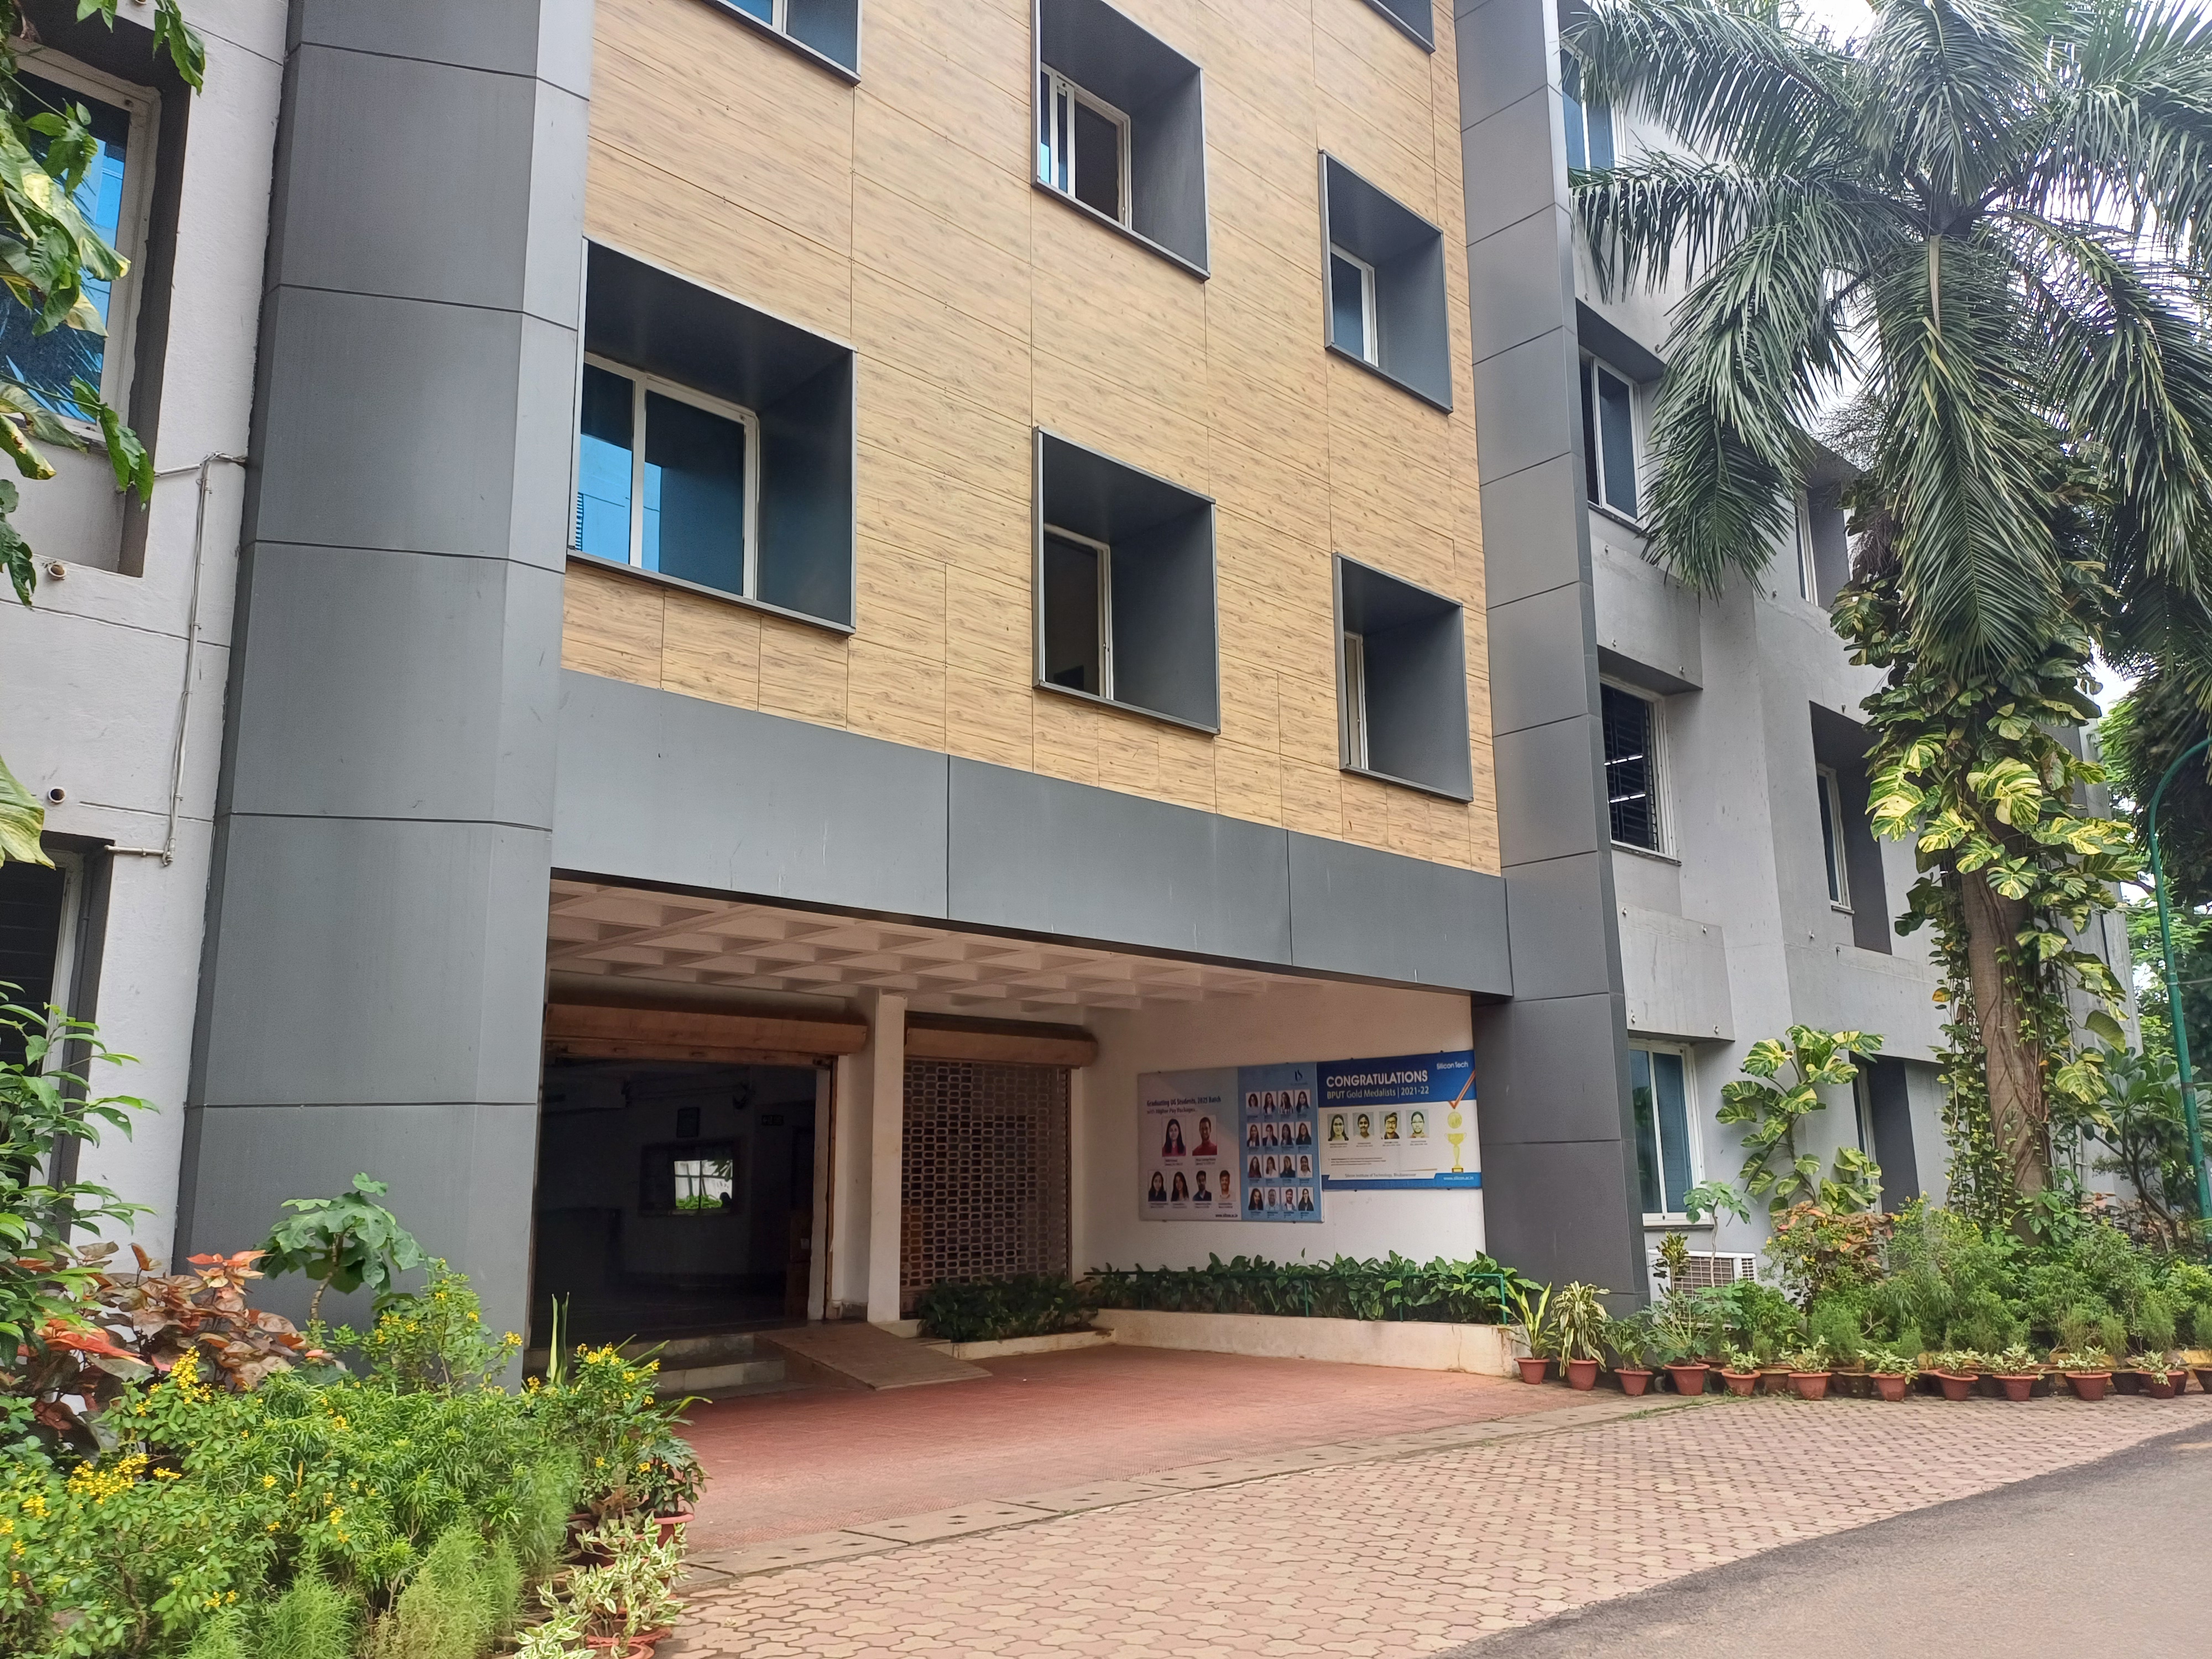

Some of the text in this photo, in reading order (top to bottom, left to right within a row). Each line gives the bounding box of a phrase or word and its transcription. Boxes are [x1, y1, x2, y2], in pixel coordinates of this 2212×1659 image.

[1326, 1070, 1428, 1087] CONGRATULATIONS
[1327, 1086, 1429, 1099] BPUT Gold Medalists 2021-22
